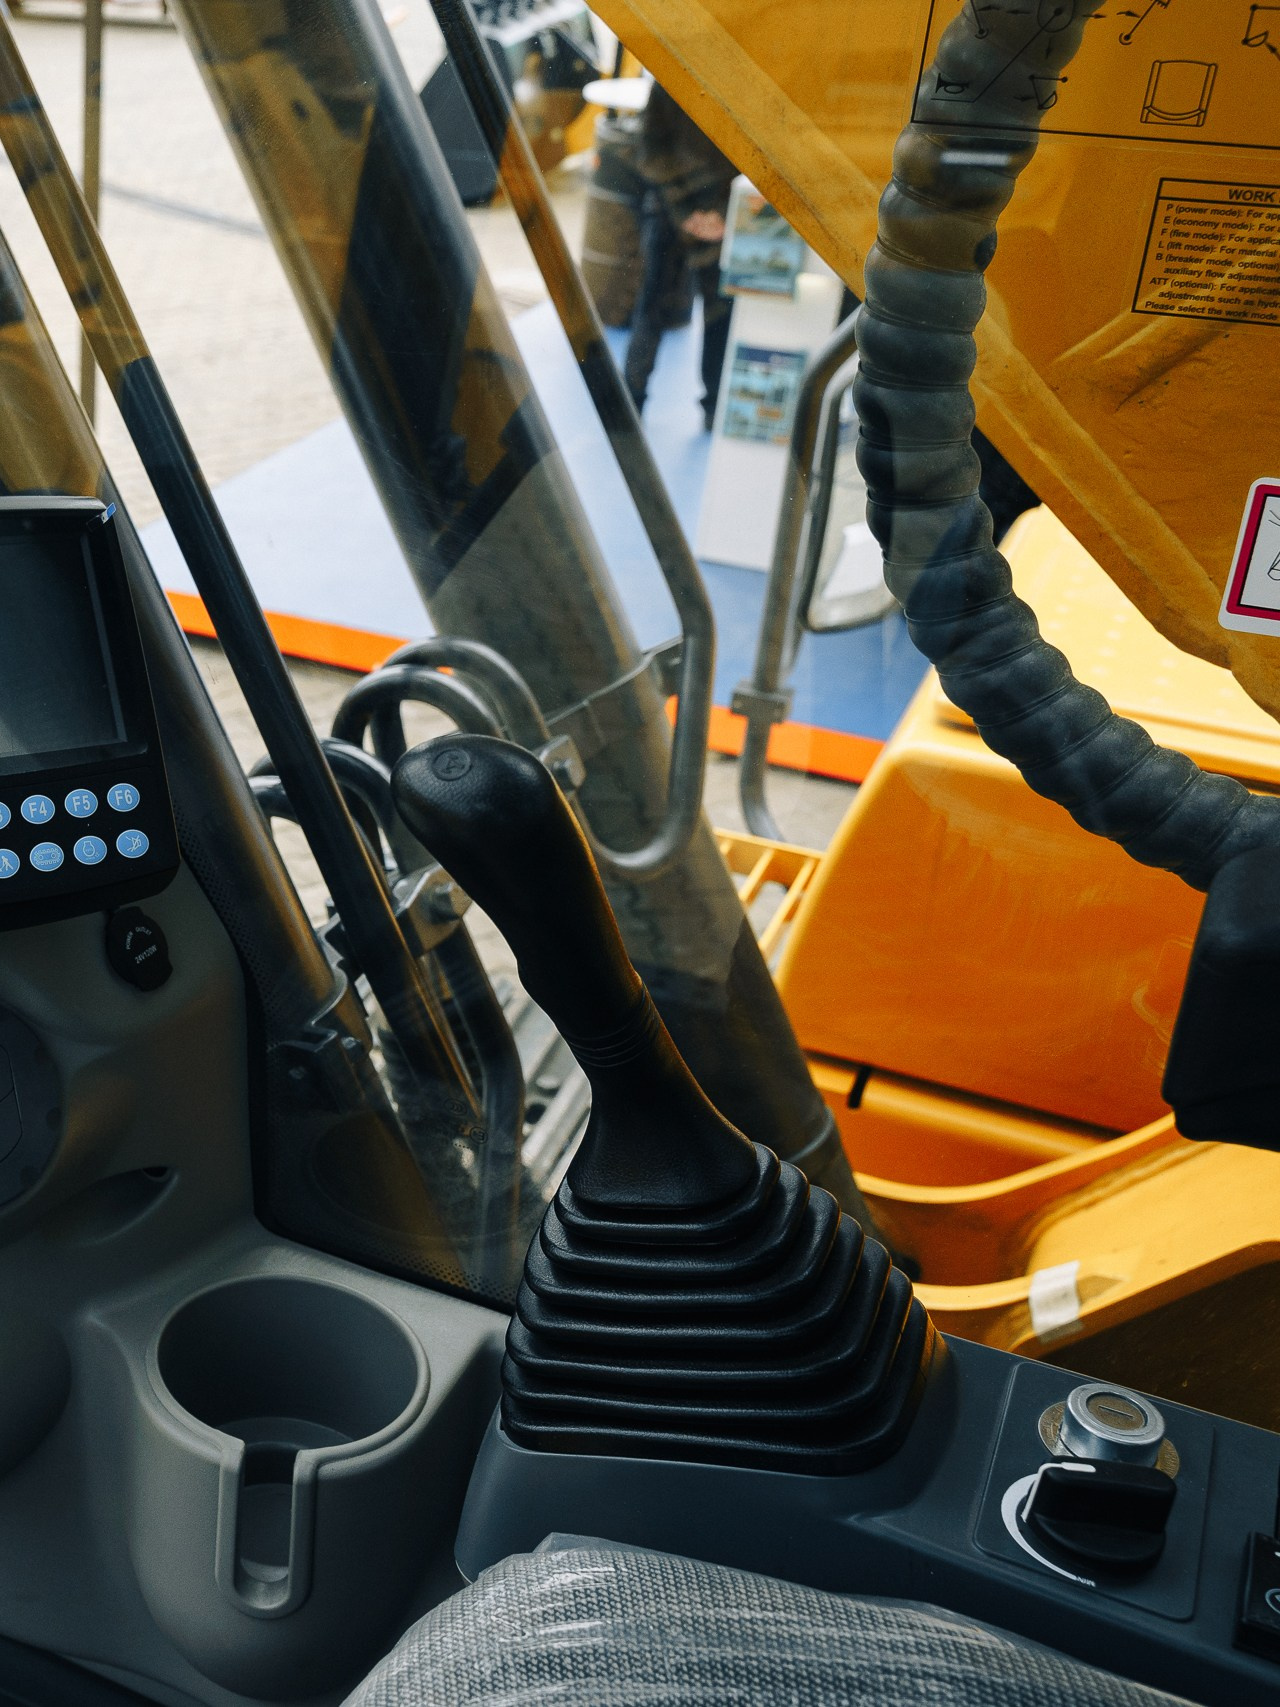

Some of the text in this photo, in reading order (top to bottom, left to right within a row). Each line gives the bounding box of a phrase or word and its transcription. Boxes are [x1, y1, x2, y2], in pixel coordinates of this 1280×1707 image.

[1228, 189, 1277, 203] WORK
[1166, 203, 1173, 211] P
[1175, 205, 1208, 215] (power
[1246, 209, 1264, 218] For
[1163, 216, 1171, 224] E
[1173, 217, 1219, 230] (economy
[1222, 222, 1254, 232] mode):
[1258, 223, 1275, 232] For
[1160, 228, 1168, 236] F
[1169, 229, 1190, 238] (fine
[1228, 234, 1245, 242] For
[1158, 241, 1164, 249] L
[1166, 241, 1182, 251] (lift
[1219, 246, 1236, 254] For
[1238, 248, 1277, 257] material
[1155, 253, 1162, 261] B
[1165, 253, 1203, 264] (breaker
[1163, 267, 1203, 278] auxiliary
[1205, 269, 1225, 278] flow
[1149, 277, 1169, 285] ATT
[1170, 279, 1216, 291] (optional):
[1219, 283, 1237, 292] For
[1158, 291, 1215, 303] adjustments
[1217, 296, 1241, 305] such
[1145, 301, 1277, 320] Please select the work mode
[28, 800, 48, 818] F4
[72, 794, 91, 812] F5
[114, 788, 133, 806] F6
